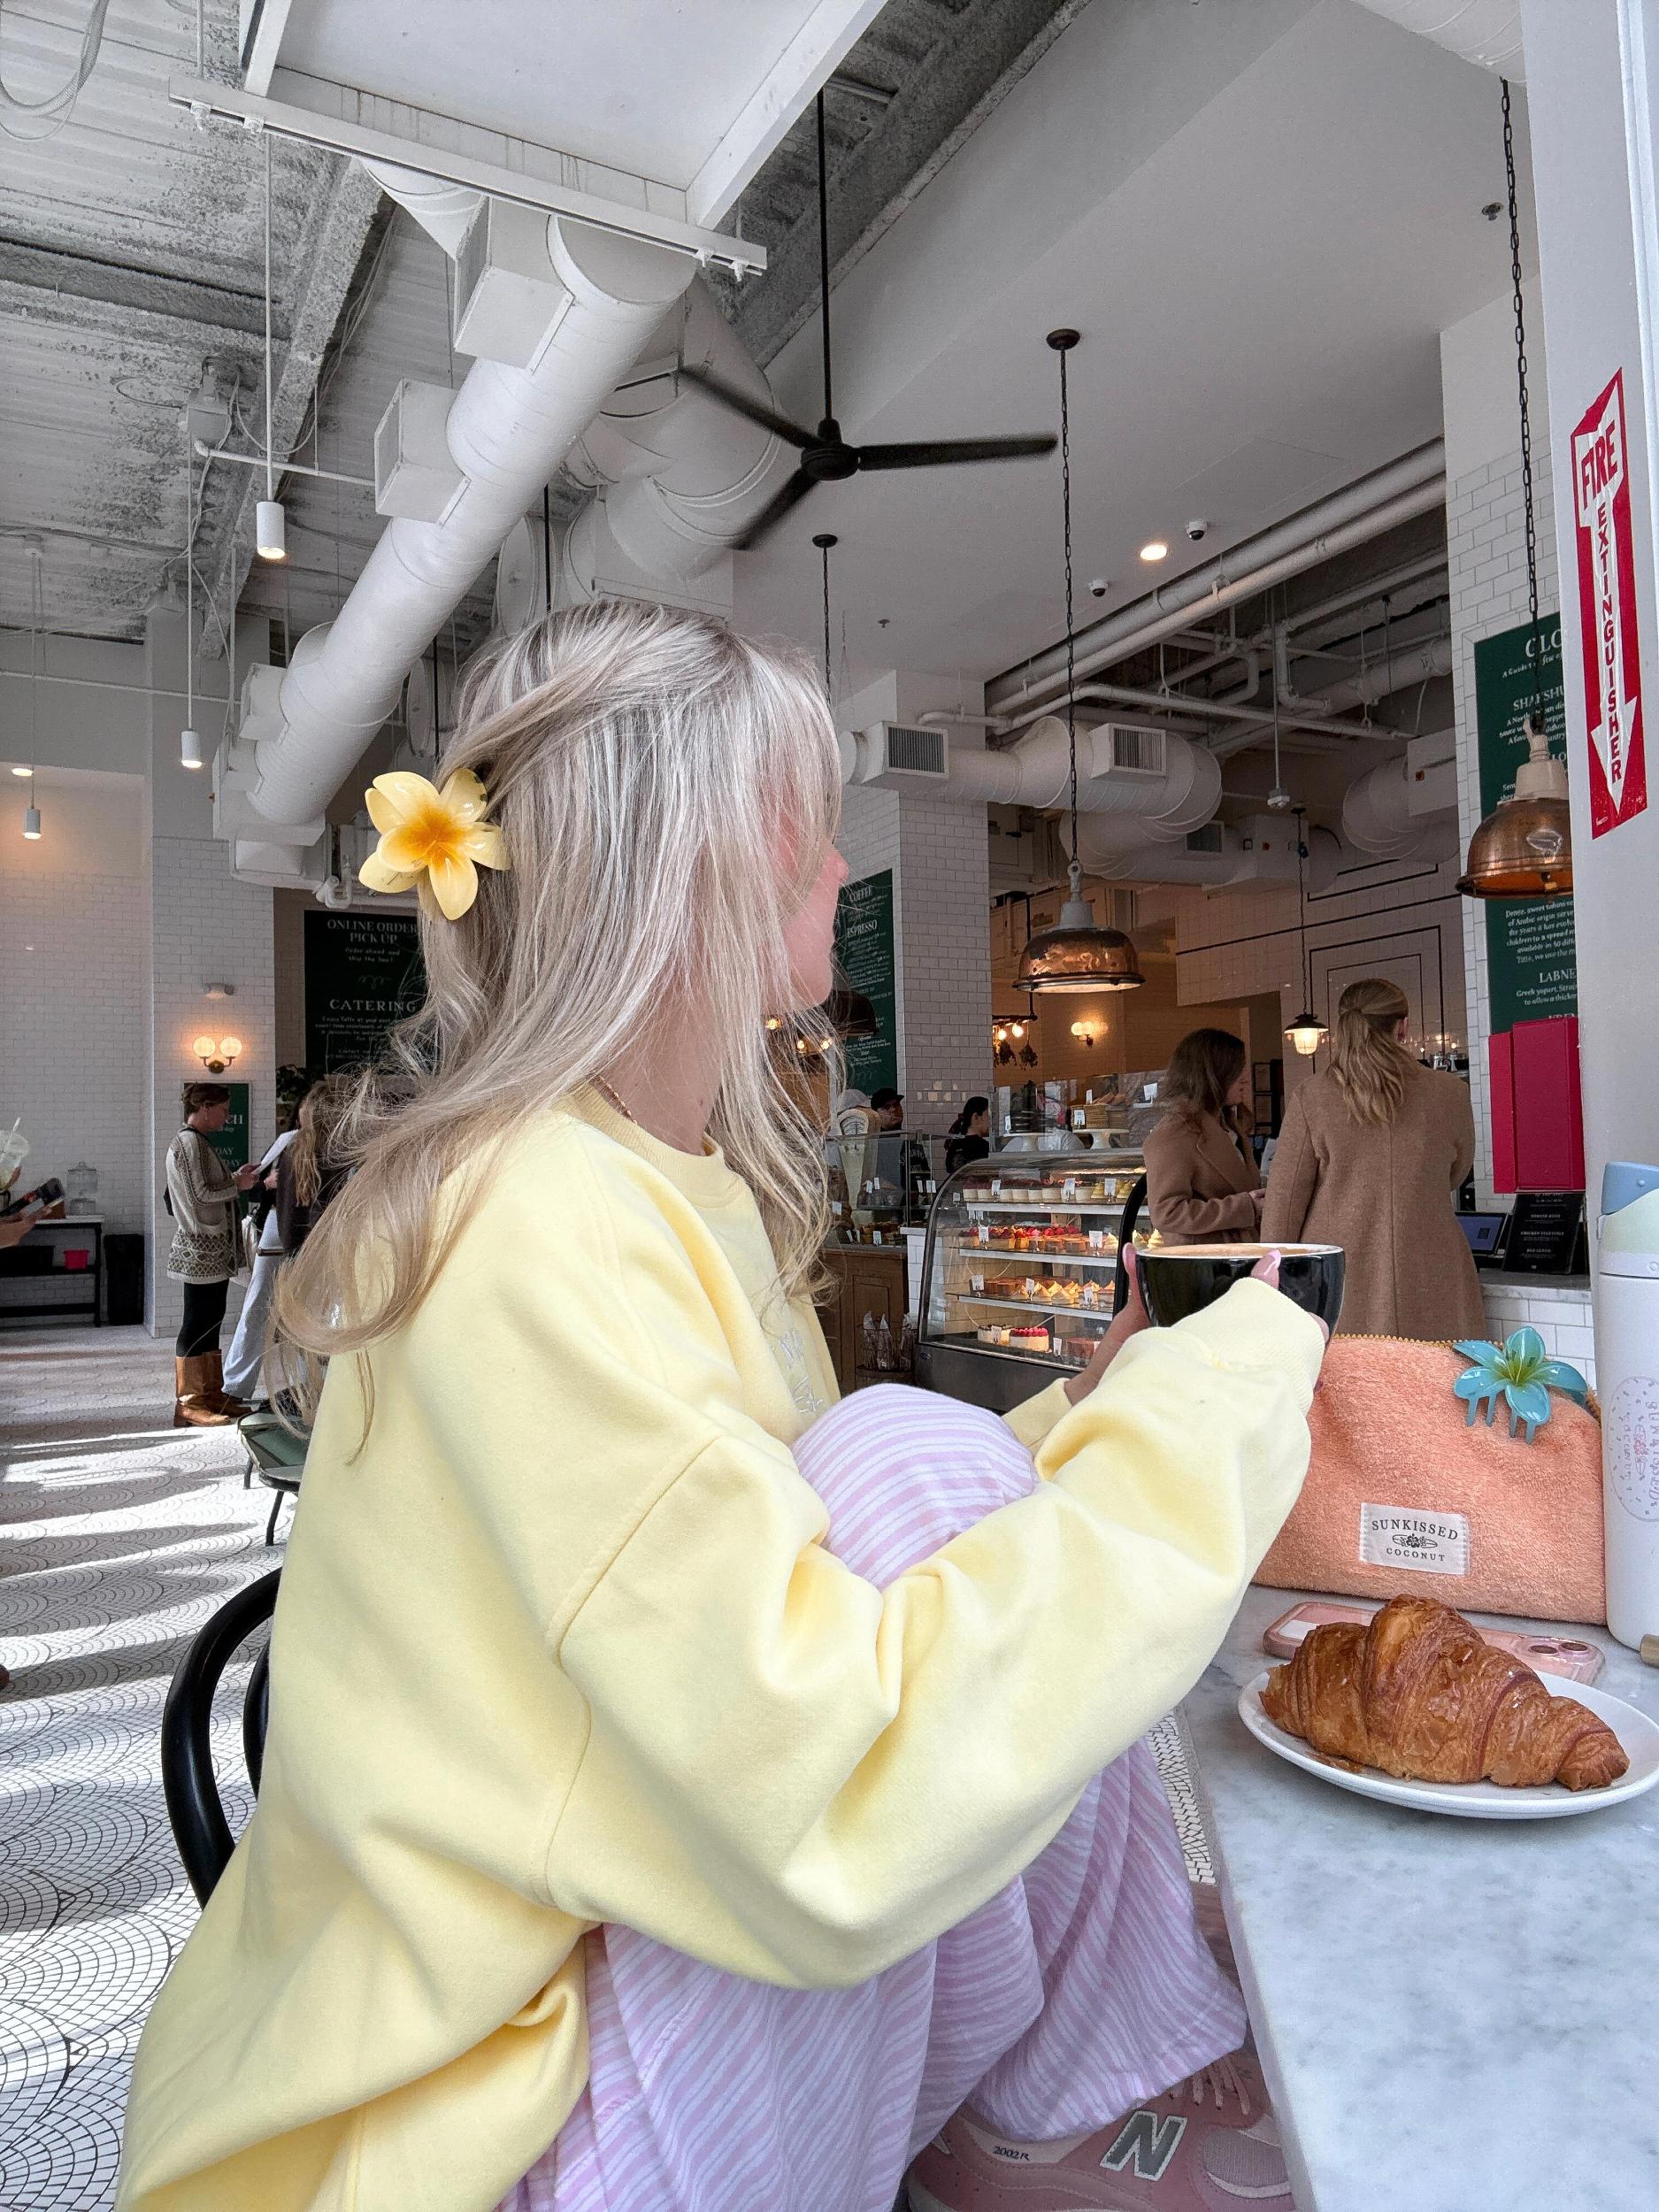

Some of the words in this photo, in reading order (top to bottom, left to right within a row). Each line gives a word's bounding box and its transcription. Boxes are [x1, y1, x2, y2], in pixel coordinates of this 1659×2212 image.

[1581, 419, 1618, 511] FIRE
[1598, 502, 1622, 783] EXTINGUISHER
[327, 919, 373, 932] ONLINE
[847, 919, 878, 939] ESPRESSO
[329, 999, 416, 1012] CATERING
[1371, 1519, 1458, 1540] SUNKISSED
[1386, 1548, 1446, 1562] COCONUT
[992, 2145, 1030, 2162] 2002R
[1099, 2110, 1188, 2182] N
